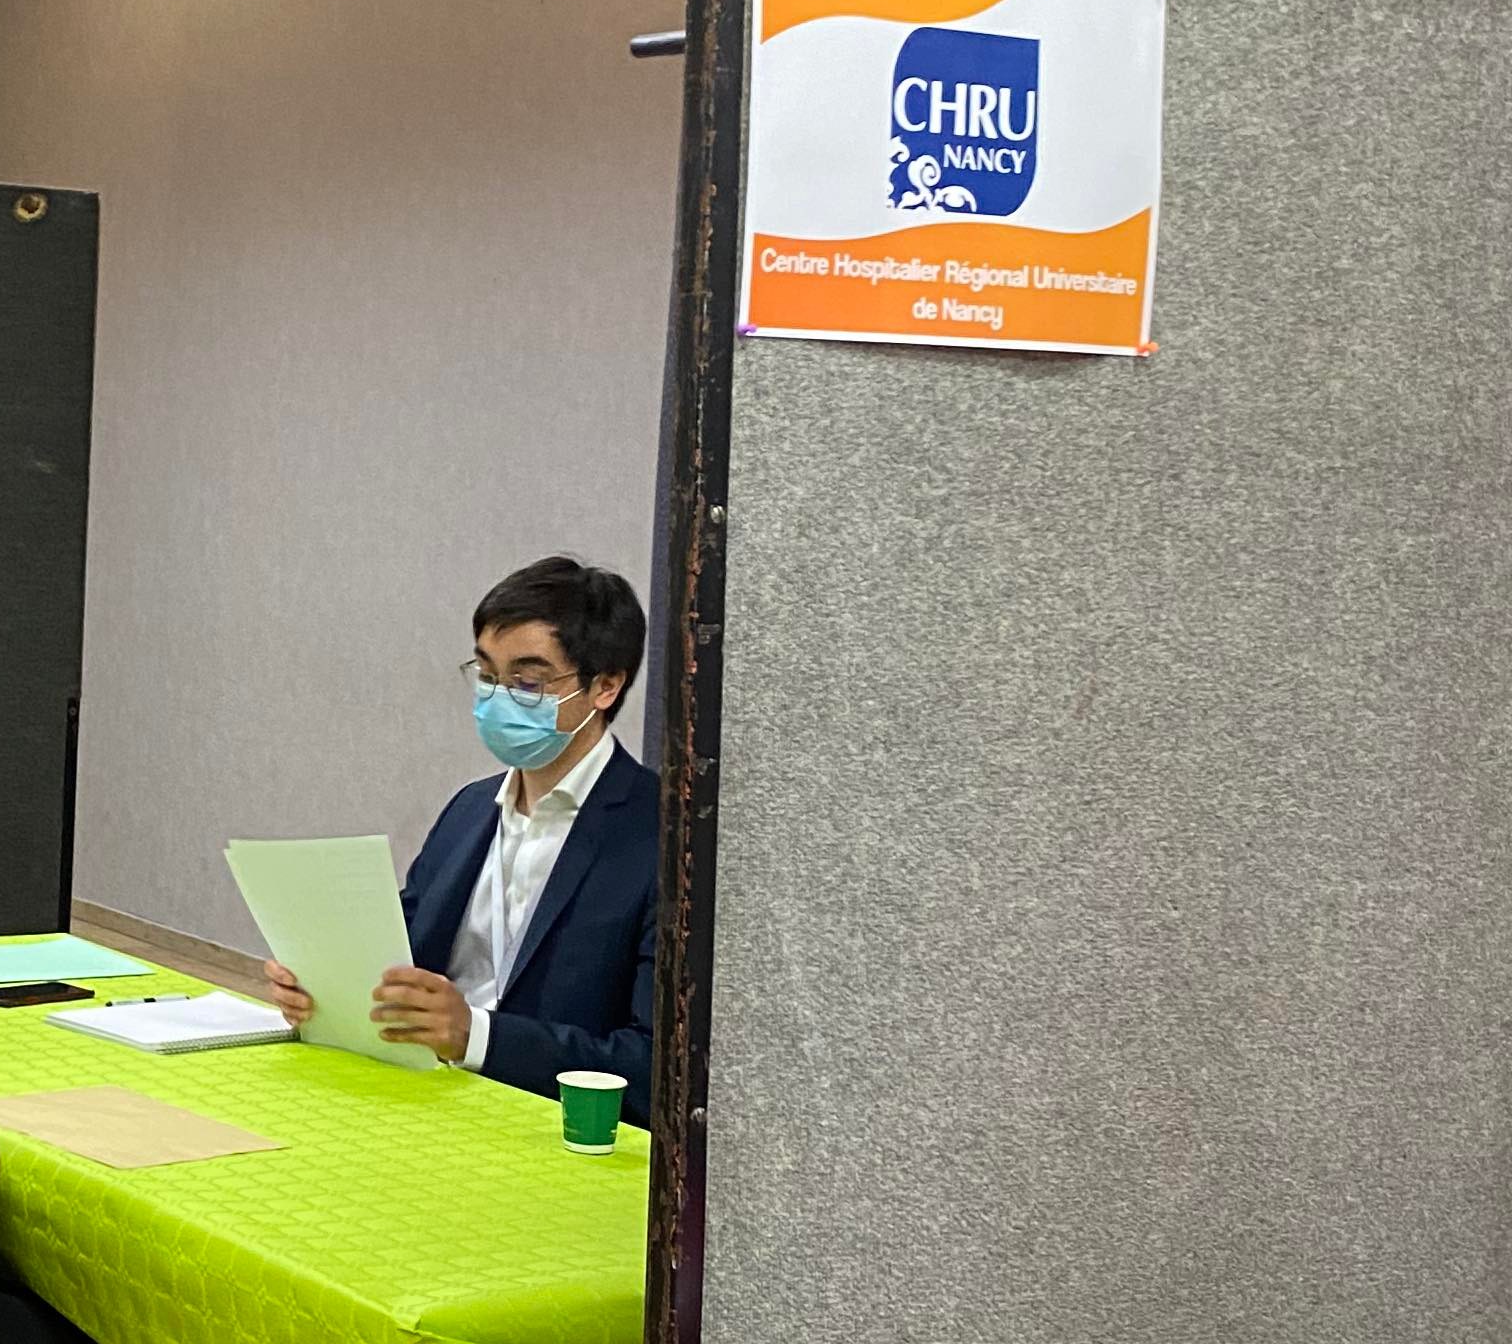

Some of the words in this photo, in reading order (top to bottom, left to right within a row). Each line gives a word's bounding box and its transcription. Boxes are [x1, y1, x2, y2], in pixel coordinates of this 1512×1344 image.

[894, 76, 1036, 141] CHRU
[943, 143, 1027, 175] NANCY
[760, 247, 830, 275] Centre
[833, 253, 940, 286] Hospitalier
[945, 260, 1029, 293] Régional
[1033, 266, 1138, 297] Universitaire
[912, 297, 938, 320] de
[942, 298, 1005, 331] Nancy
